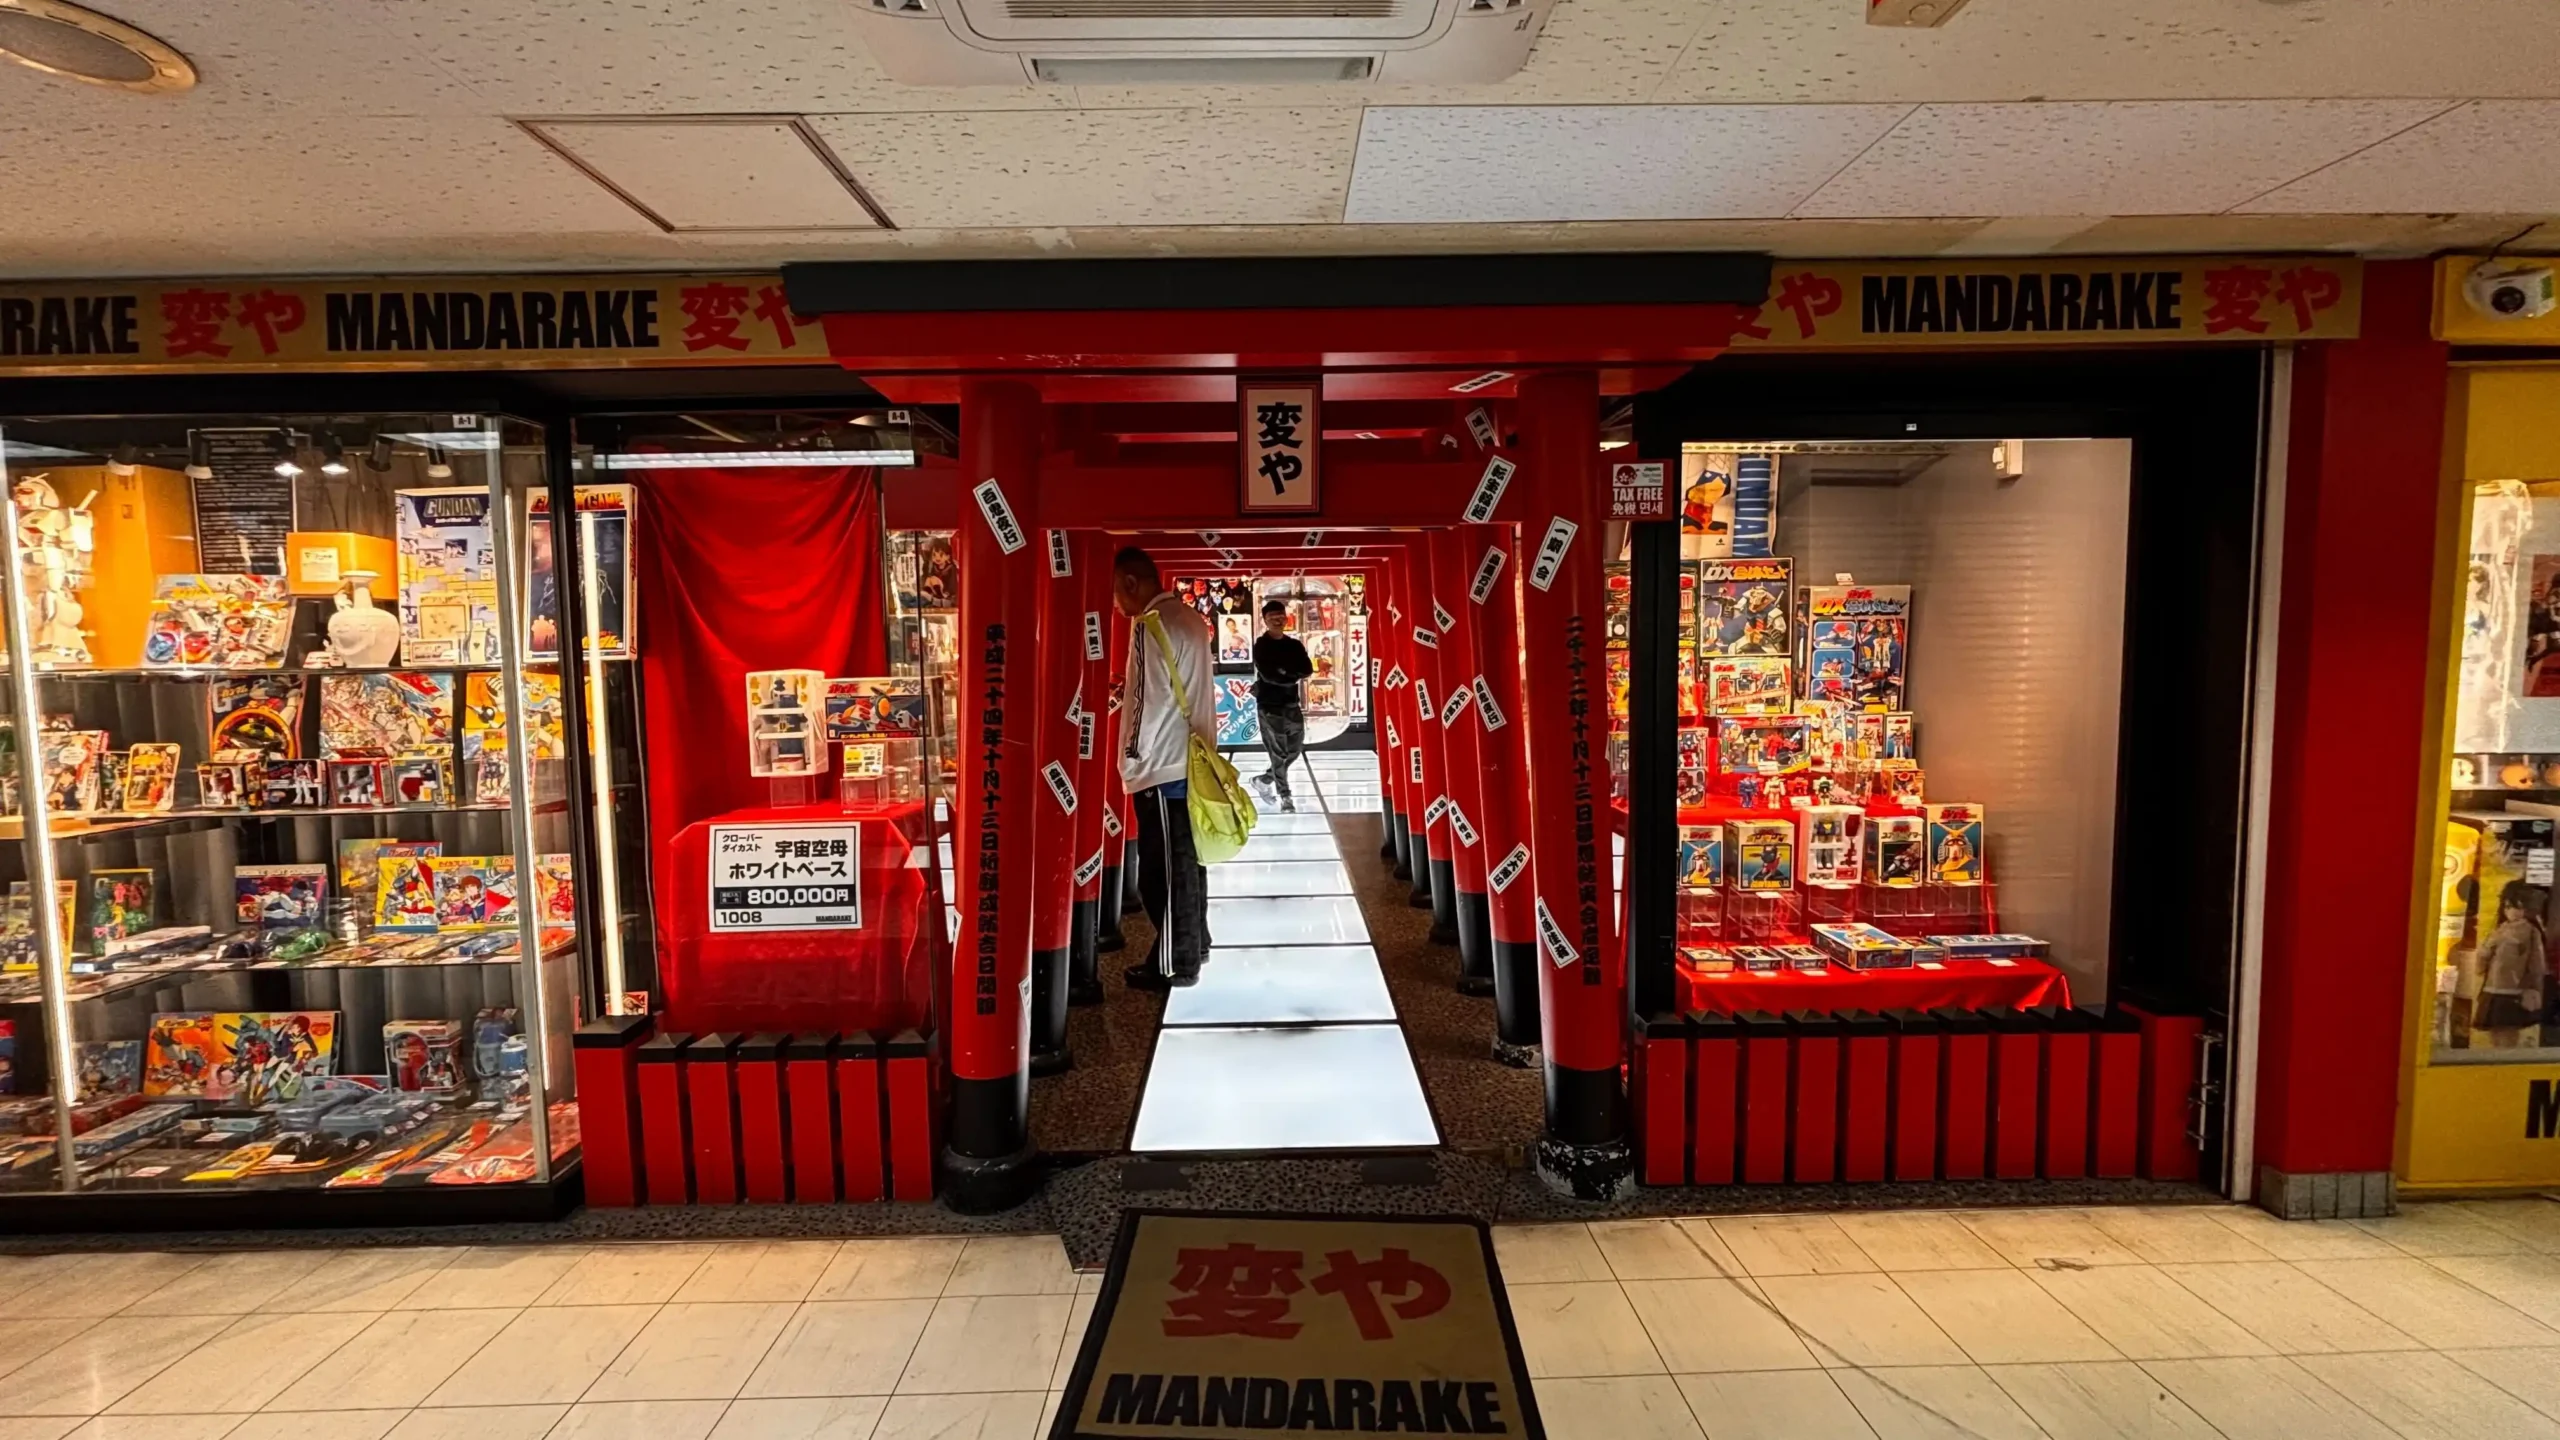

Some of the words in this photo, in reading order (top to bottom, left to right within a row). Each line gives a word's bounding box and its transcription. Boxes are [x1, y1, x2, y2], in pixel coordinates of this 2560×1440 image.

[1862, 271, 2181, 333] MANDARAKE
[2203, 264, 2342, 335] 変や
[161, 287, 306, 358] 変や
[326, 289, 660, 352] MANDARAKE
[1256, 401, 1303, 495] 変や
[423, 497, 484, 517] GUNDAM
[1612, 502, 1636, 515] 免税
[1613, 488, 1635, 501] TAX
[1637, 487, 1664, 501] FREE
[1639, 502, 1664, 515] 면세
[981, 487, 1018, 546] 百鬼夜行
[1536, 528, 1568, 582] 一期一会
[1350, 628, 1365, 713] キリンビール
[722, 834, 763, 843] クローバー
[722, 844, 762, 853] ダイカスト
[775, 840, 848, 858] 宇宙空母
[729, 861, 847, 880] ホワイトベース
[747, 888, 849, 905] 800,000円
[720, 911, 762, 924] 1008
[1161, 1242, 1452, 1340] 変や
[1096, 1373, 1507, 1435] MANDARAKE
